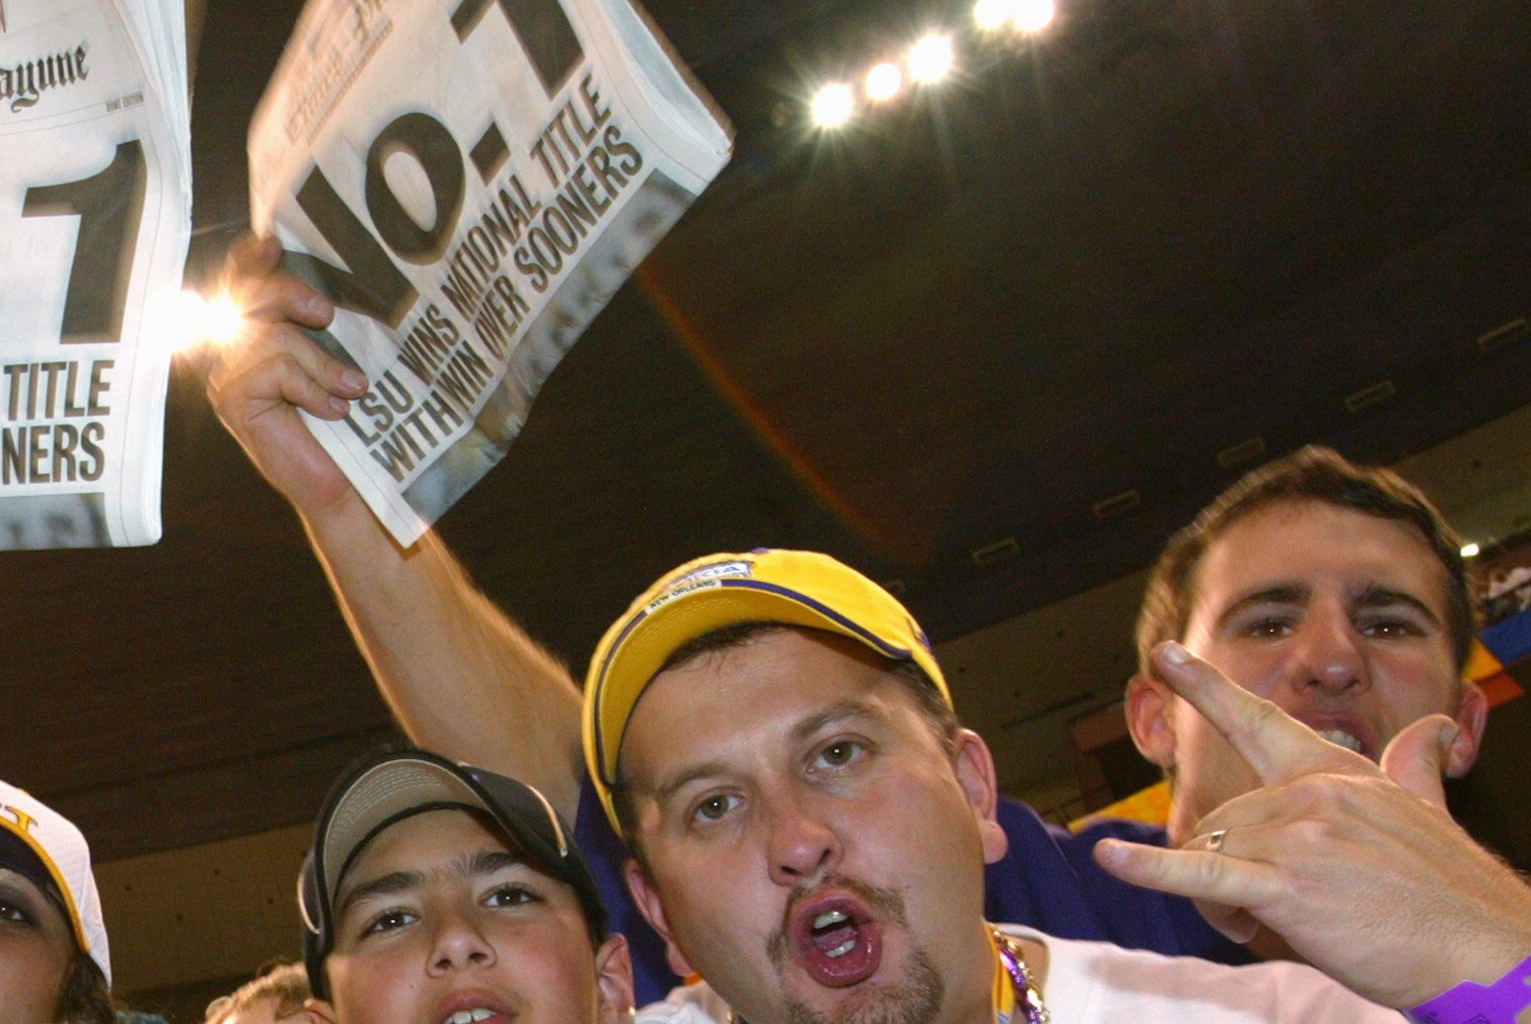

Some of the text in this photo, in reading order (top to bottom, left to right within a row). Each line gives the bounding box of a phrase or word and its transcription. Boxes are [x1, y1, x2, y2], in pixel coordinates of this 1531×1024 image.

[4, 360, 115, 421] TITLE
[345, 72, 612, 447] LSU WINS NATIONAL TITLE
[368, 124, 644, 484] WITH WIN OVER SOONERS
